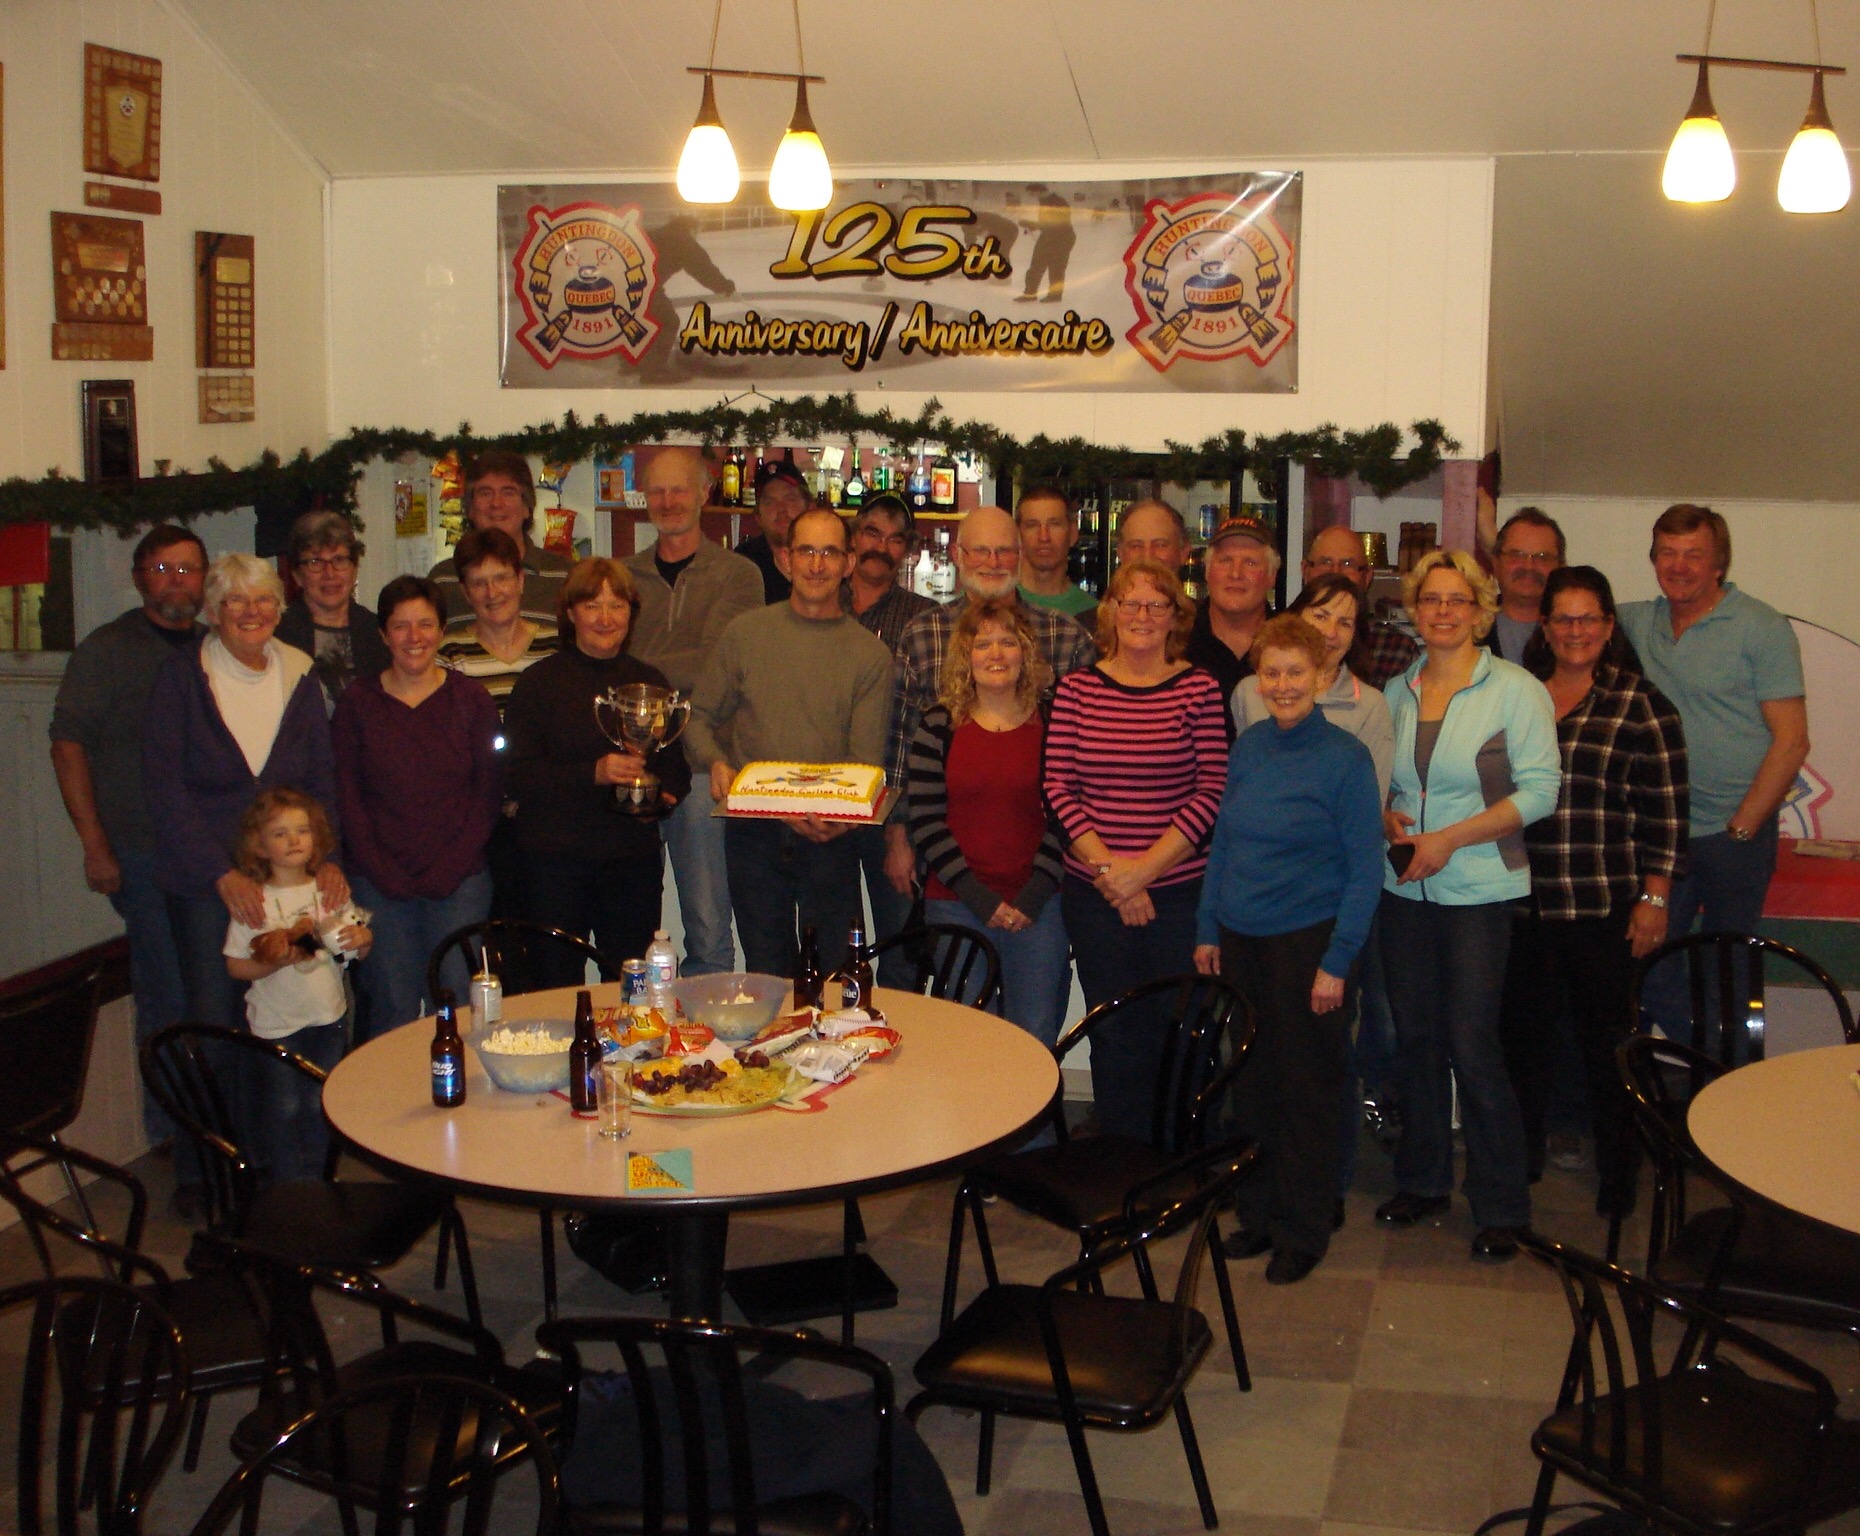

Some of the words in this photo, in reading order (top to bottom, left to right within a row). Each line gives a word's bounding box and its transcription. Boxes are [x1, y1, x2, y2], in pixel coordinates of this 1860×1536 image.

[540, 221, 636, 262] HUNTINGDON
[770, 201, 1013, 282] 125th
[1154, 216, 1268, 256] HUNTINGON
[567, 289, 612, 303] QUEBEC
[1187, 287, 1241, 302] QUEBEC
[572, 317, 614, 334] 1891
[899, 301, 1115, 358] Anniversaire
[1191, 316, 1239, 334] 1891
